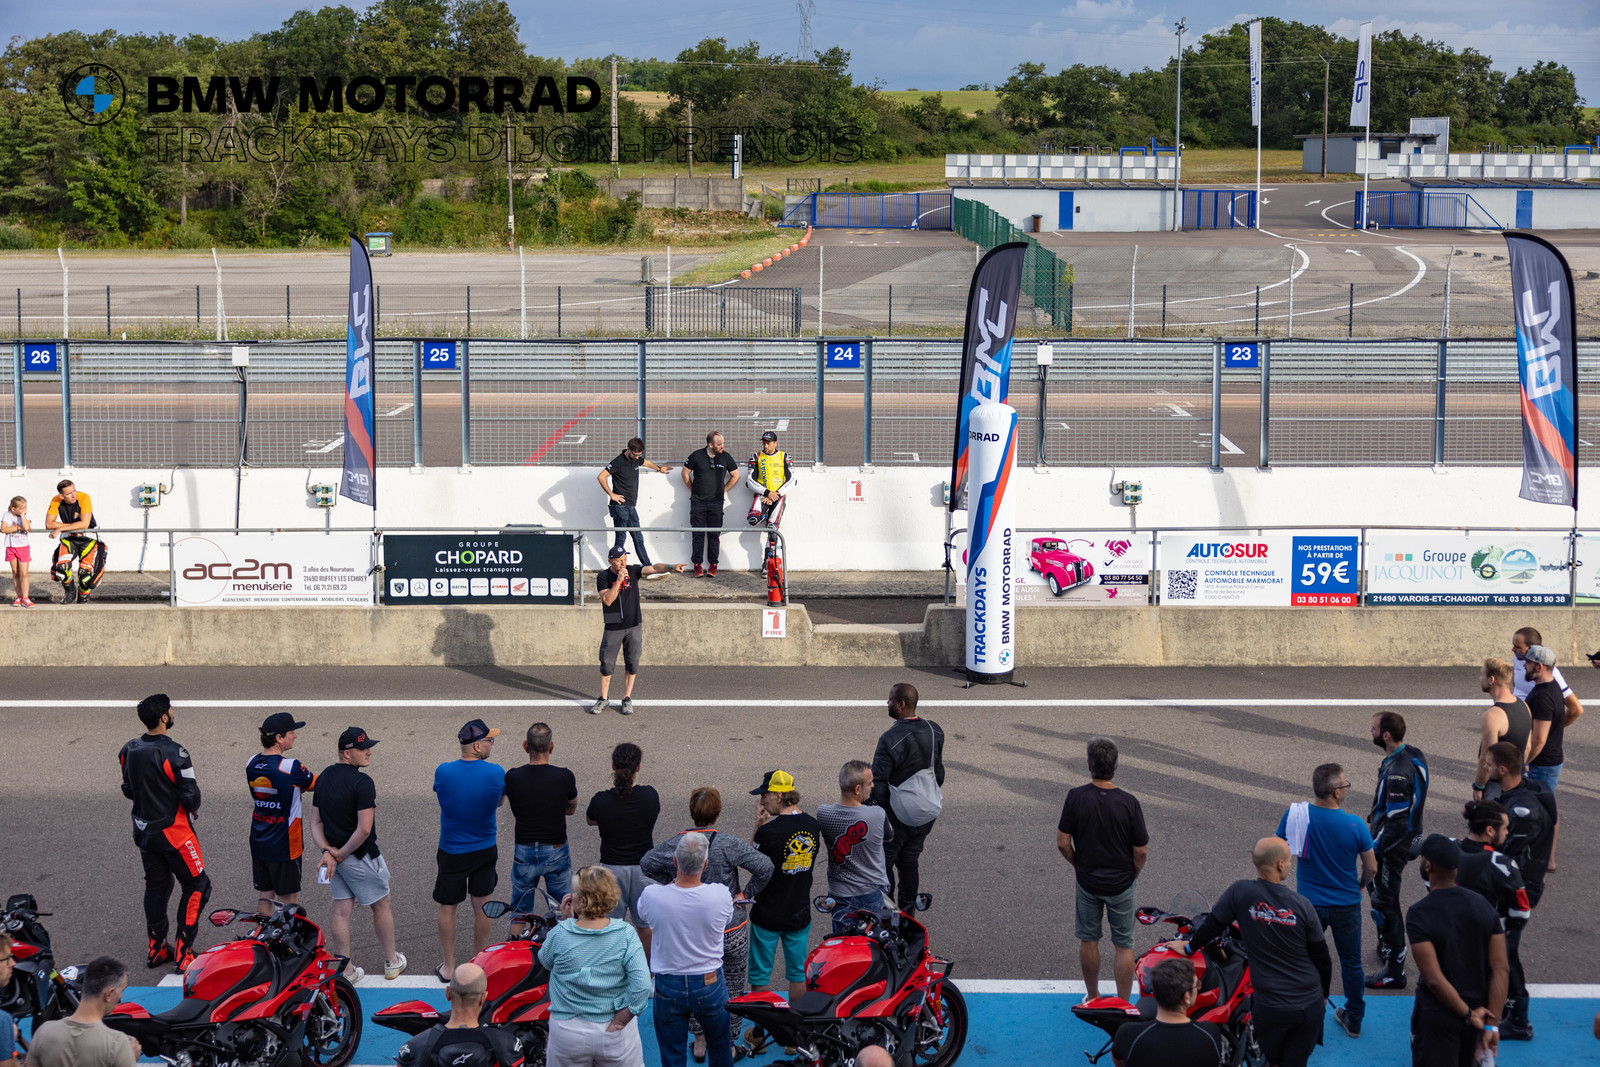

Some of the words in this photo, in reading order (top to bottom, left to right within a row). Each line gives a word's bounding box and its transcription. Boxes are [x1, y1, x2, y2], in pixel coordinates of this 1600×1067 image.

[31, 350, 50, 364] 26
[430, 348, 450, 362] 25
[834, 347, 853, 361] 24
[1232, 347, 1252, 361] 23
[435, 550, 523, 565] CHOPARD
[1186, 543, 1268, 558] AUTOSUR
[1307, 551, 1312, 559] À
[1424, 550, 1467, 564] Groupe
[183, 558, 292, 580] ac2m
[1002, 528, 1011, 606] MOTORRAD
[1301, 561, 1350, 586] 59€
[1374, 565, 1467, 583] JACQUINOT
[233, 581, 293, 591] menuiserie
[974, 567, 987, 665] TRACKDAYS
[1002, 610, 1010, 645] BMW
